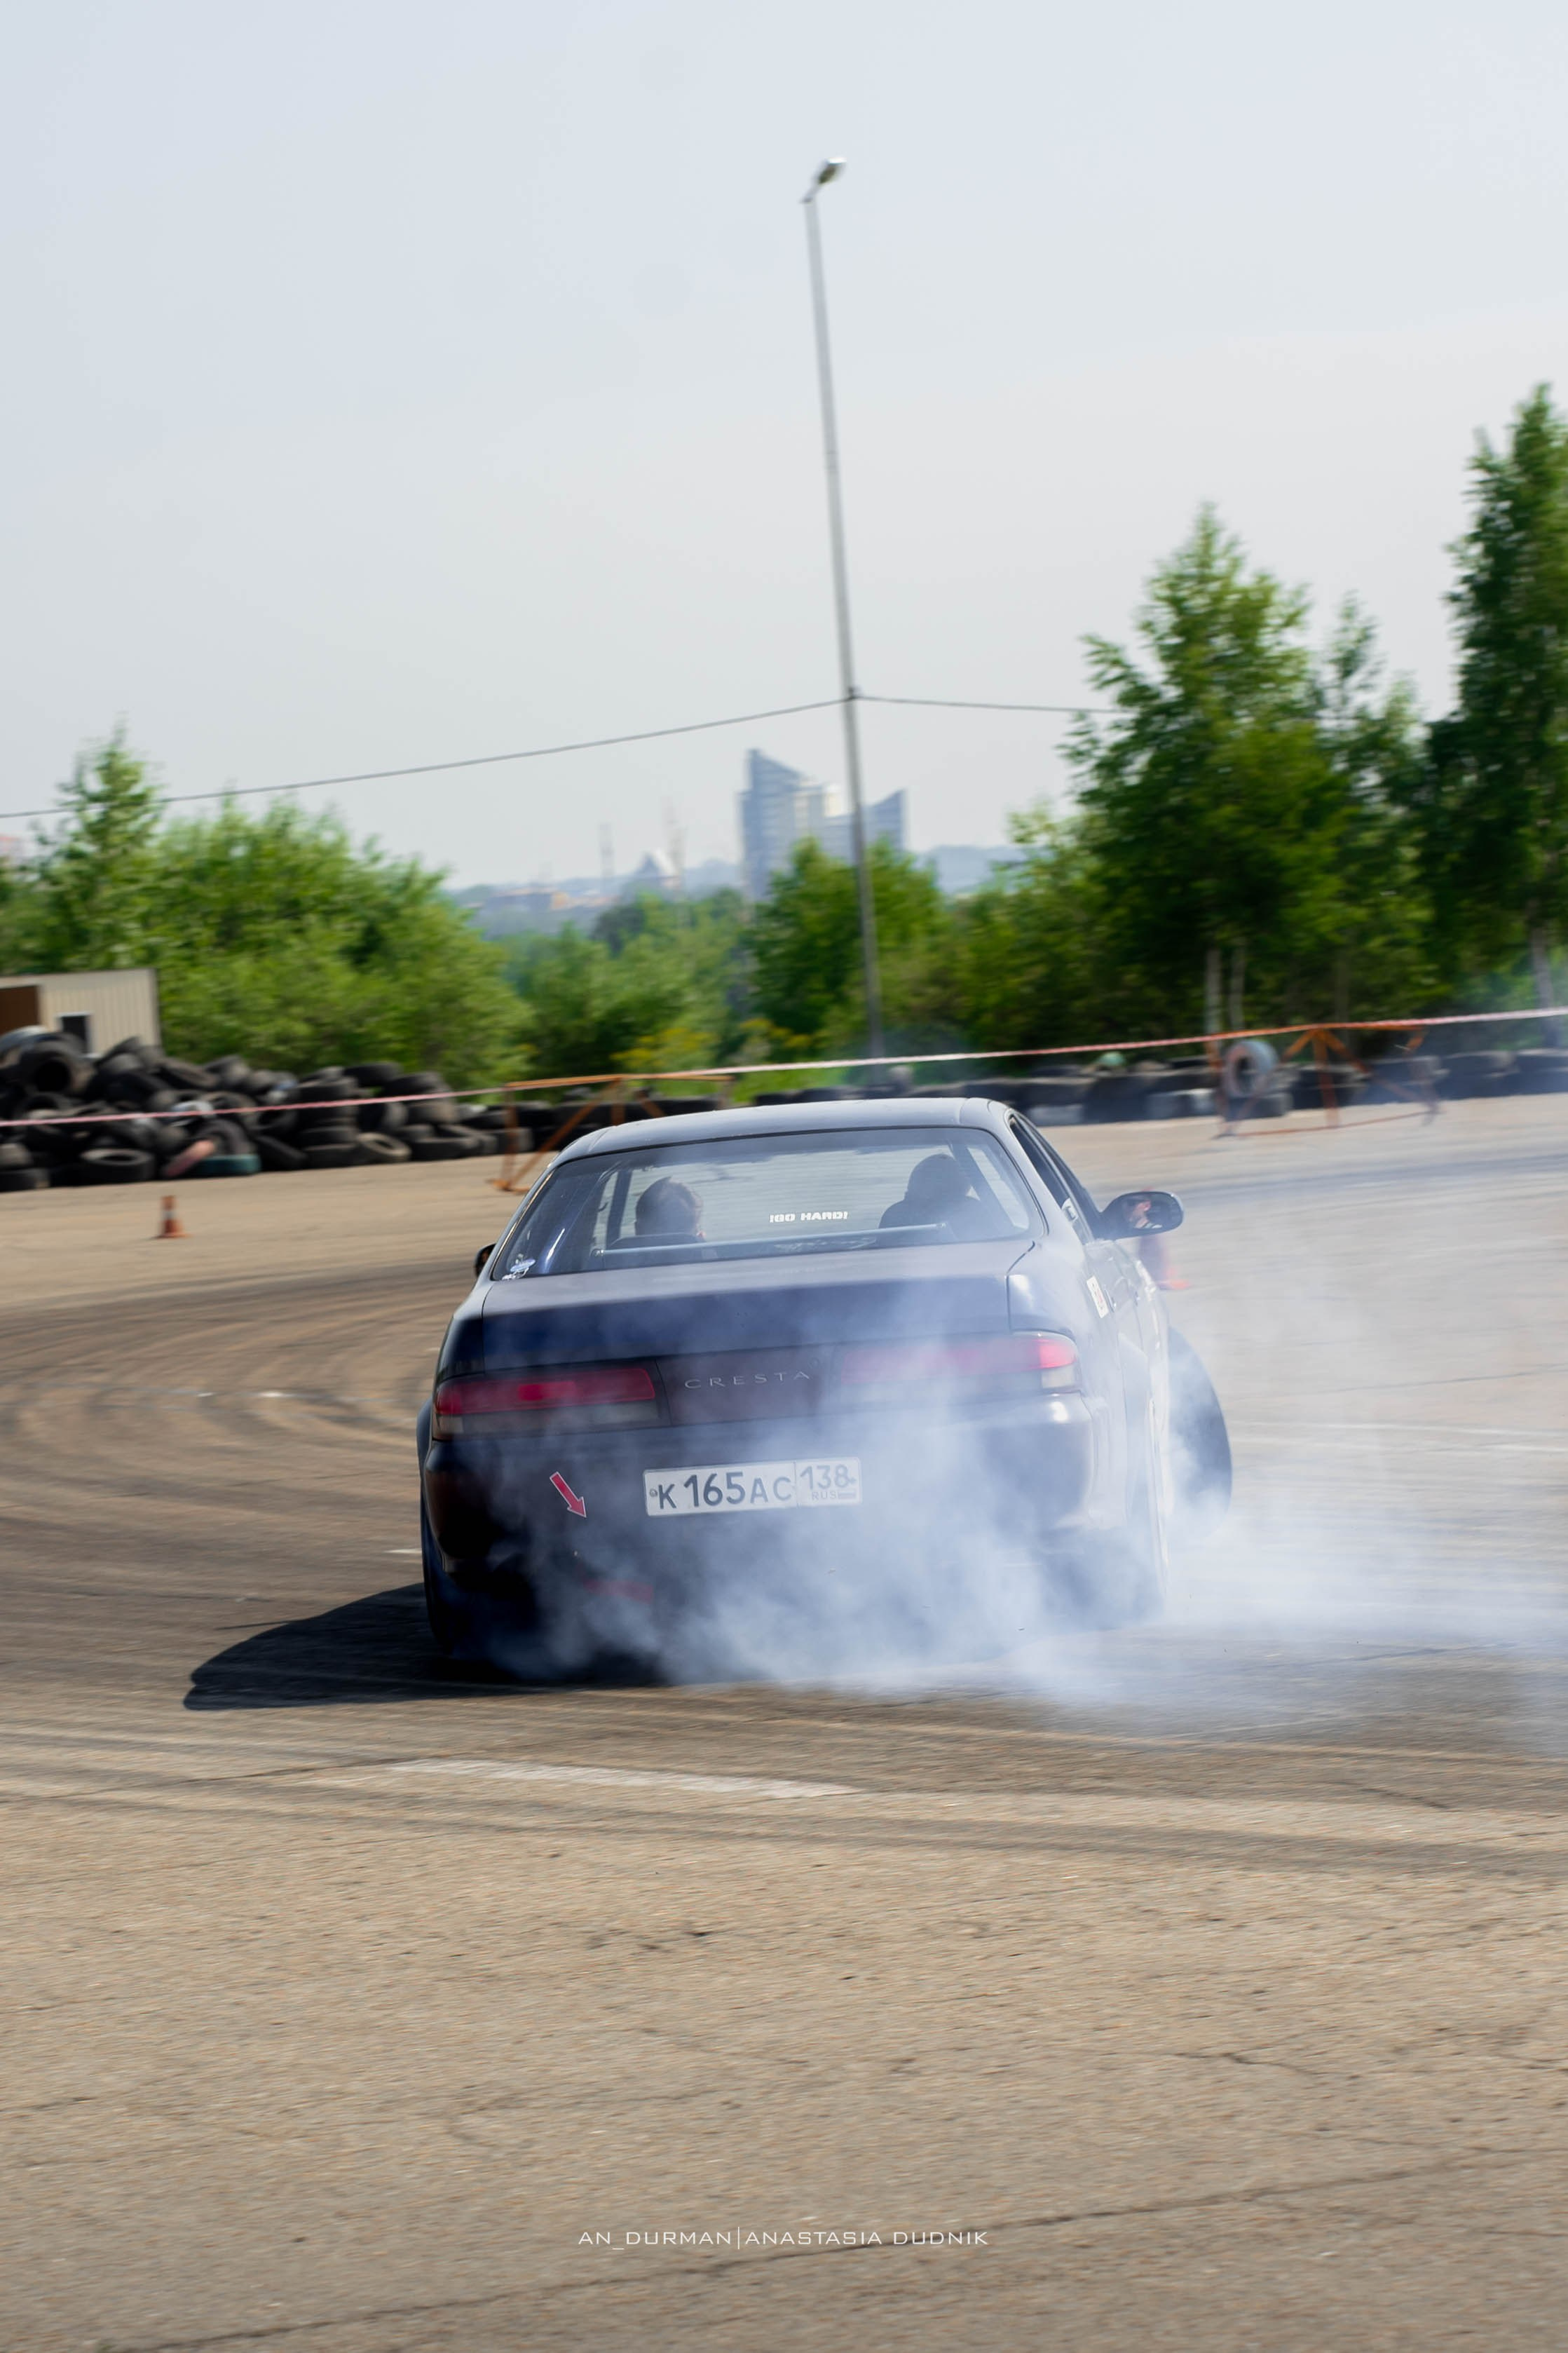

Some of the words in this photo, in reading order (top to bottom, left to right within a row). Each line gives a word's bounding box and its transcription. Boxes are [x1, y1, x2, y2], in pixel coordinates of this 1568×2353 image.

[800, 1211, 848, 1221] HARD!
[684, 1371, 810, 1389] CRESTA
[800, 1464, 850, 1490] 138
[811, 1491, 838, 1501] RUS
